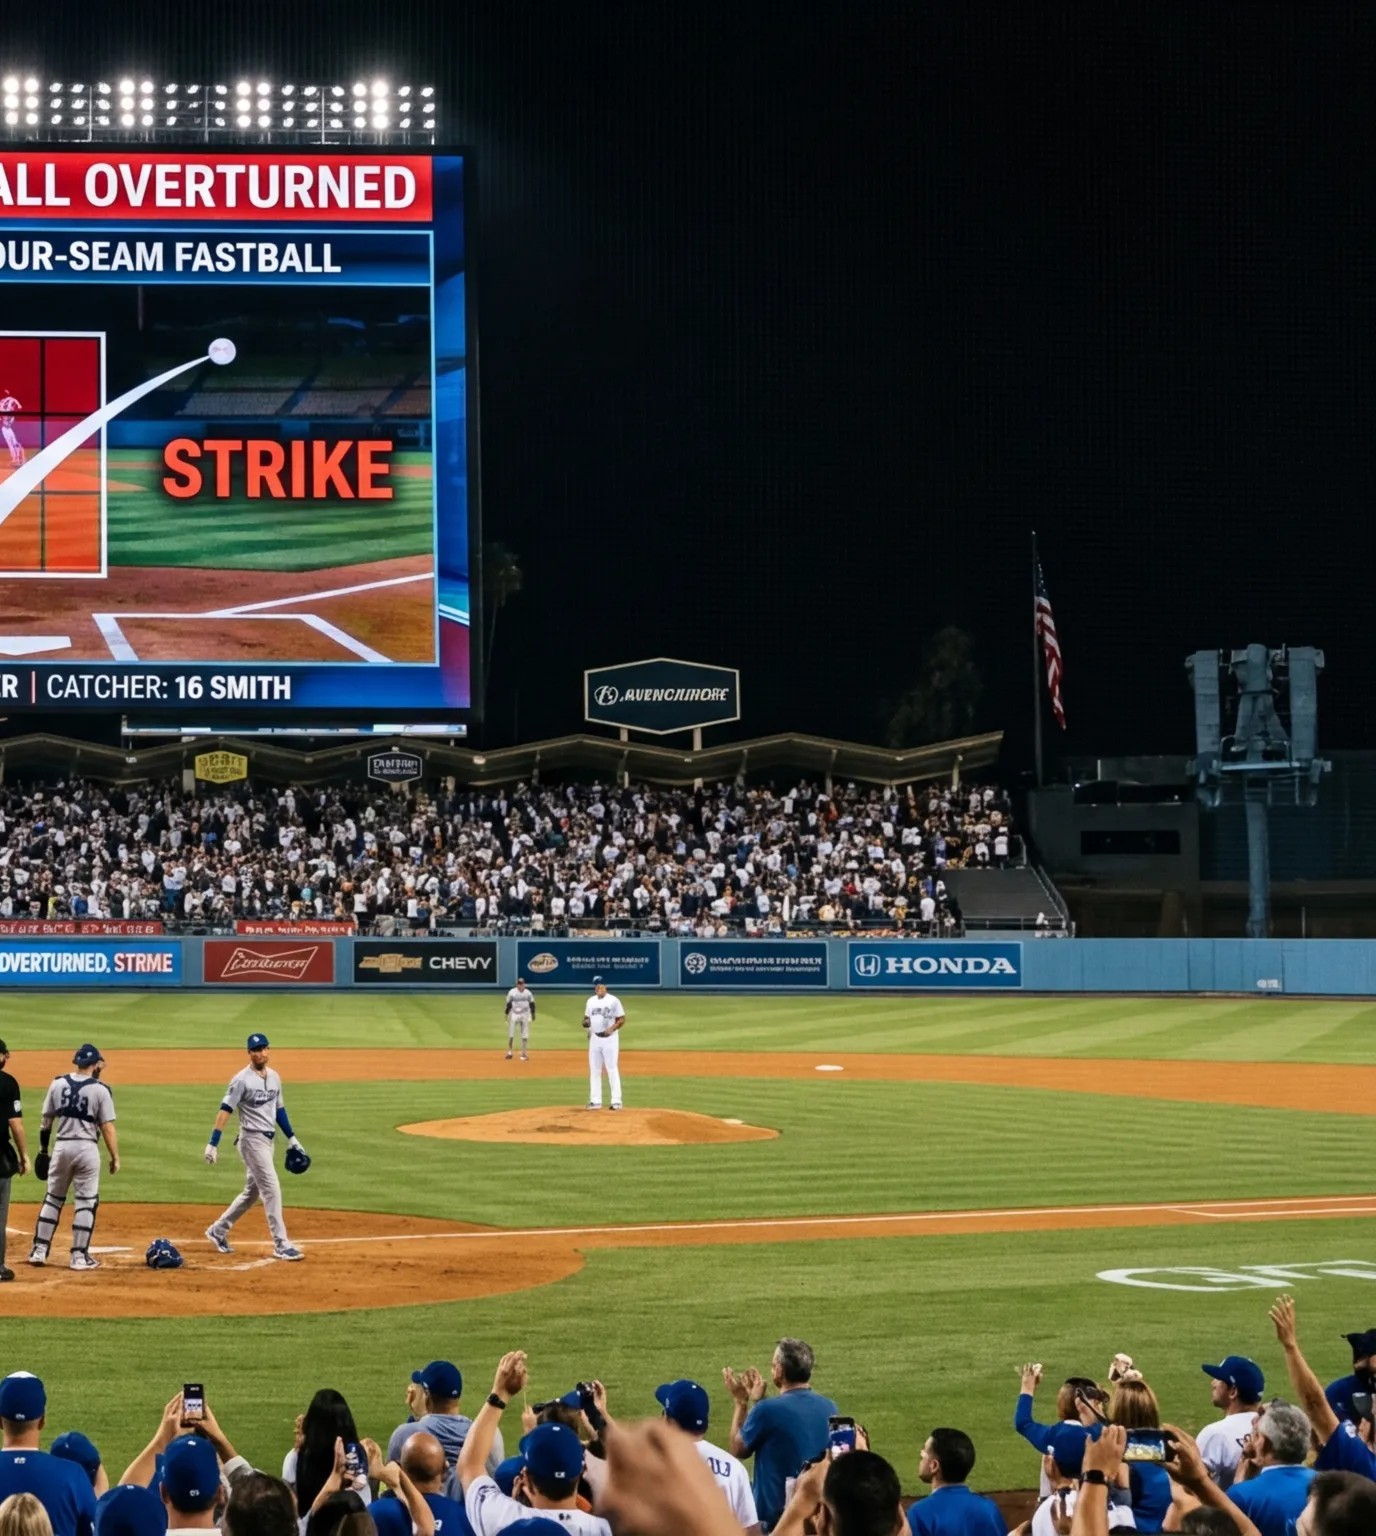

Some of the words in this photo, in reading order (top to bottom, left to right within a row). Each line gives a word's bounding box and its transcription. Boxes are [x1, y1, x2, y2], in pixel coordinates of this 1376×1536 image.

[84, 162, 416, 209] OVERTURNED
[175, 242, 342, 273] FASTBALL
[163, 438, 393, 499] STRIKE
[47, 674, 168, 699] CATCHER:
[176, 675, 204, 699] 16
[210, 675, 291, 700] SMITH
[429, 956, 492, 970] CHEVY
[885, 957, 1017, 974] HONDA
